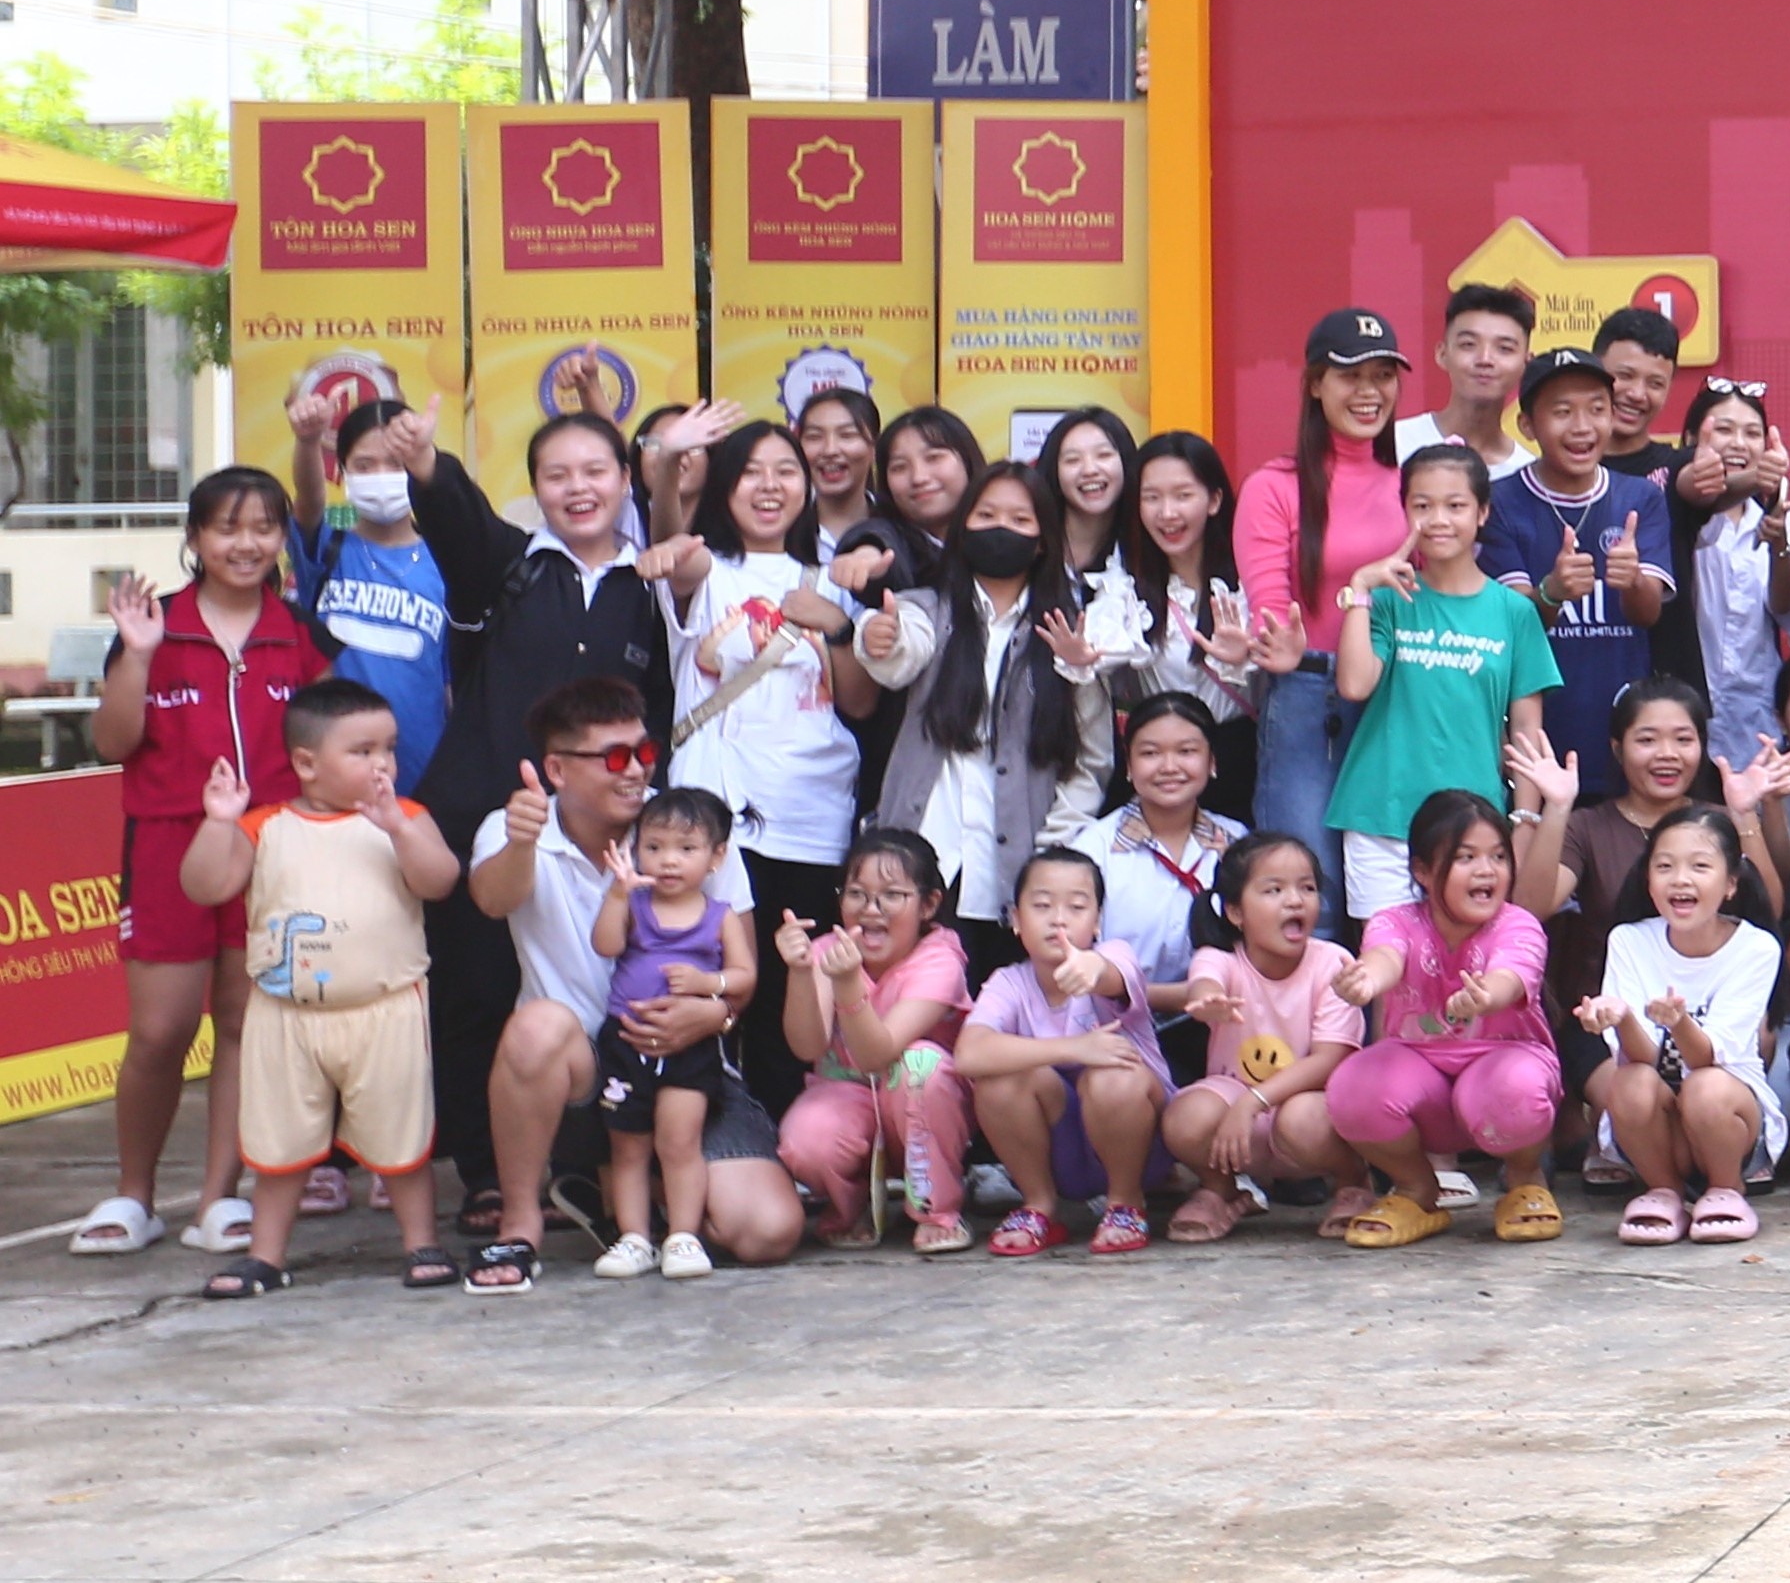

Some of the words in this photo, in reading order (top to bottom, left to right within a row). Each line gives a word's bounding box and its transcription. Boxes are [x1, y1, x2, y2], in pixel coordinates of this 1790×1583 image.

[933, 0, 1060, 86] LÀM
[270, 216, 315, 240] TÔN
[322, 221, 368, 238] HOA
[374, 220, 416, 239] SEN
[984, 213, 1020, 228] HOA
[1022, 213, 1056, 228] SEN
[1060, 210, 1116, 229] HOME
[1545, 293, 1570, 311] Mái
[1573, 294, 1595, 311] ấm
[535, 316, 592, 334] NHỰA
[601, 316, 643, 331] HOA
[650, 314, 690, 331] SEN
[956, 309, 998, 326] MUA
[1004, 304, 1059, 326] HÀNG
[1063, 309, 1139, 325] ONLINE
[1540, 318, 1560, 334] gia
[1563, 312, 1596, 331] đình
[243, 312, 304, 340] TÔN
[316, 318, 377, 339] HOA
[387, 317, 445, 337] SEN
[788, 324, 825, 338] HOA
[829, 324, 865, 338] SEN
[951, 332, 1000, 349] GIAO
[1005, 329, 1060, 349] HÀNG
[1065, 329, 1104, 351] TẬN
[1109, 332, 1143, 348] TAY
[957, 356, 1007, 374] HOA
[1011, 356, 1057, 374] SEN
[1063, 353, 1139, 374] HOME
[1559, 626, 1584, 638] LIVE
[1584, 625, 1633, 638] LIMITLESS
